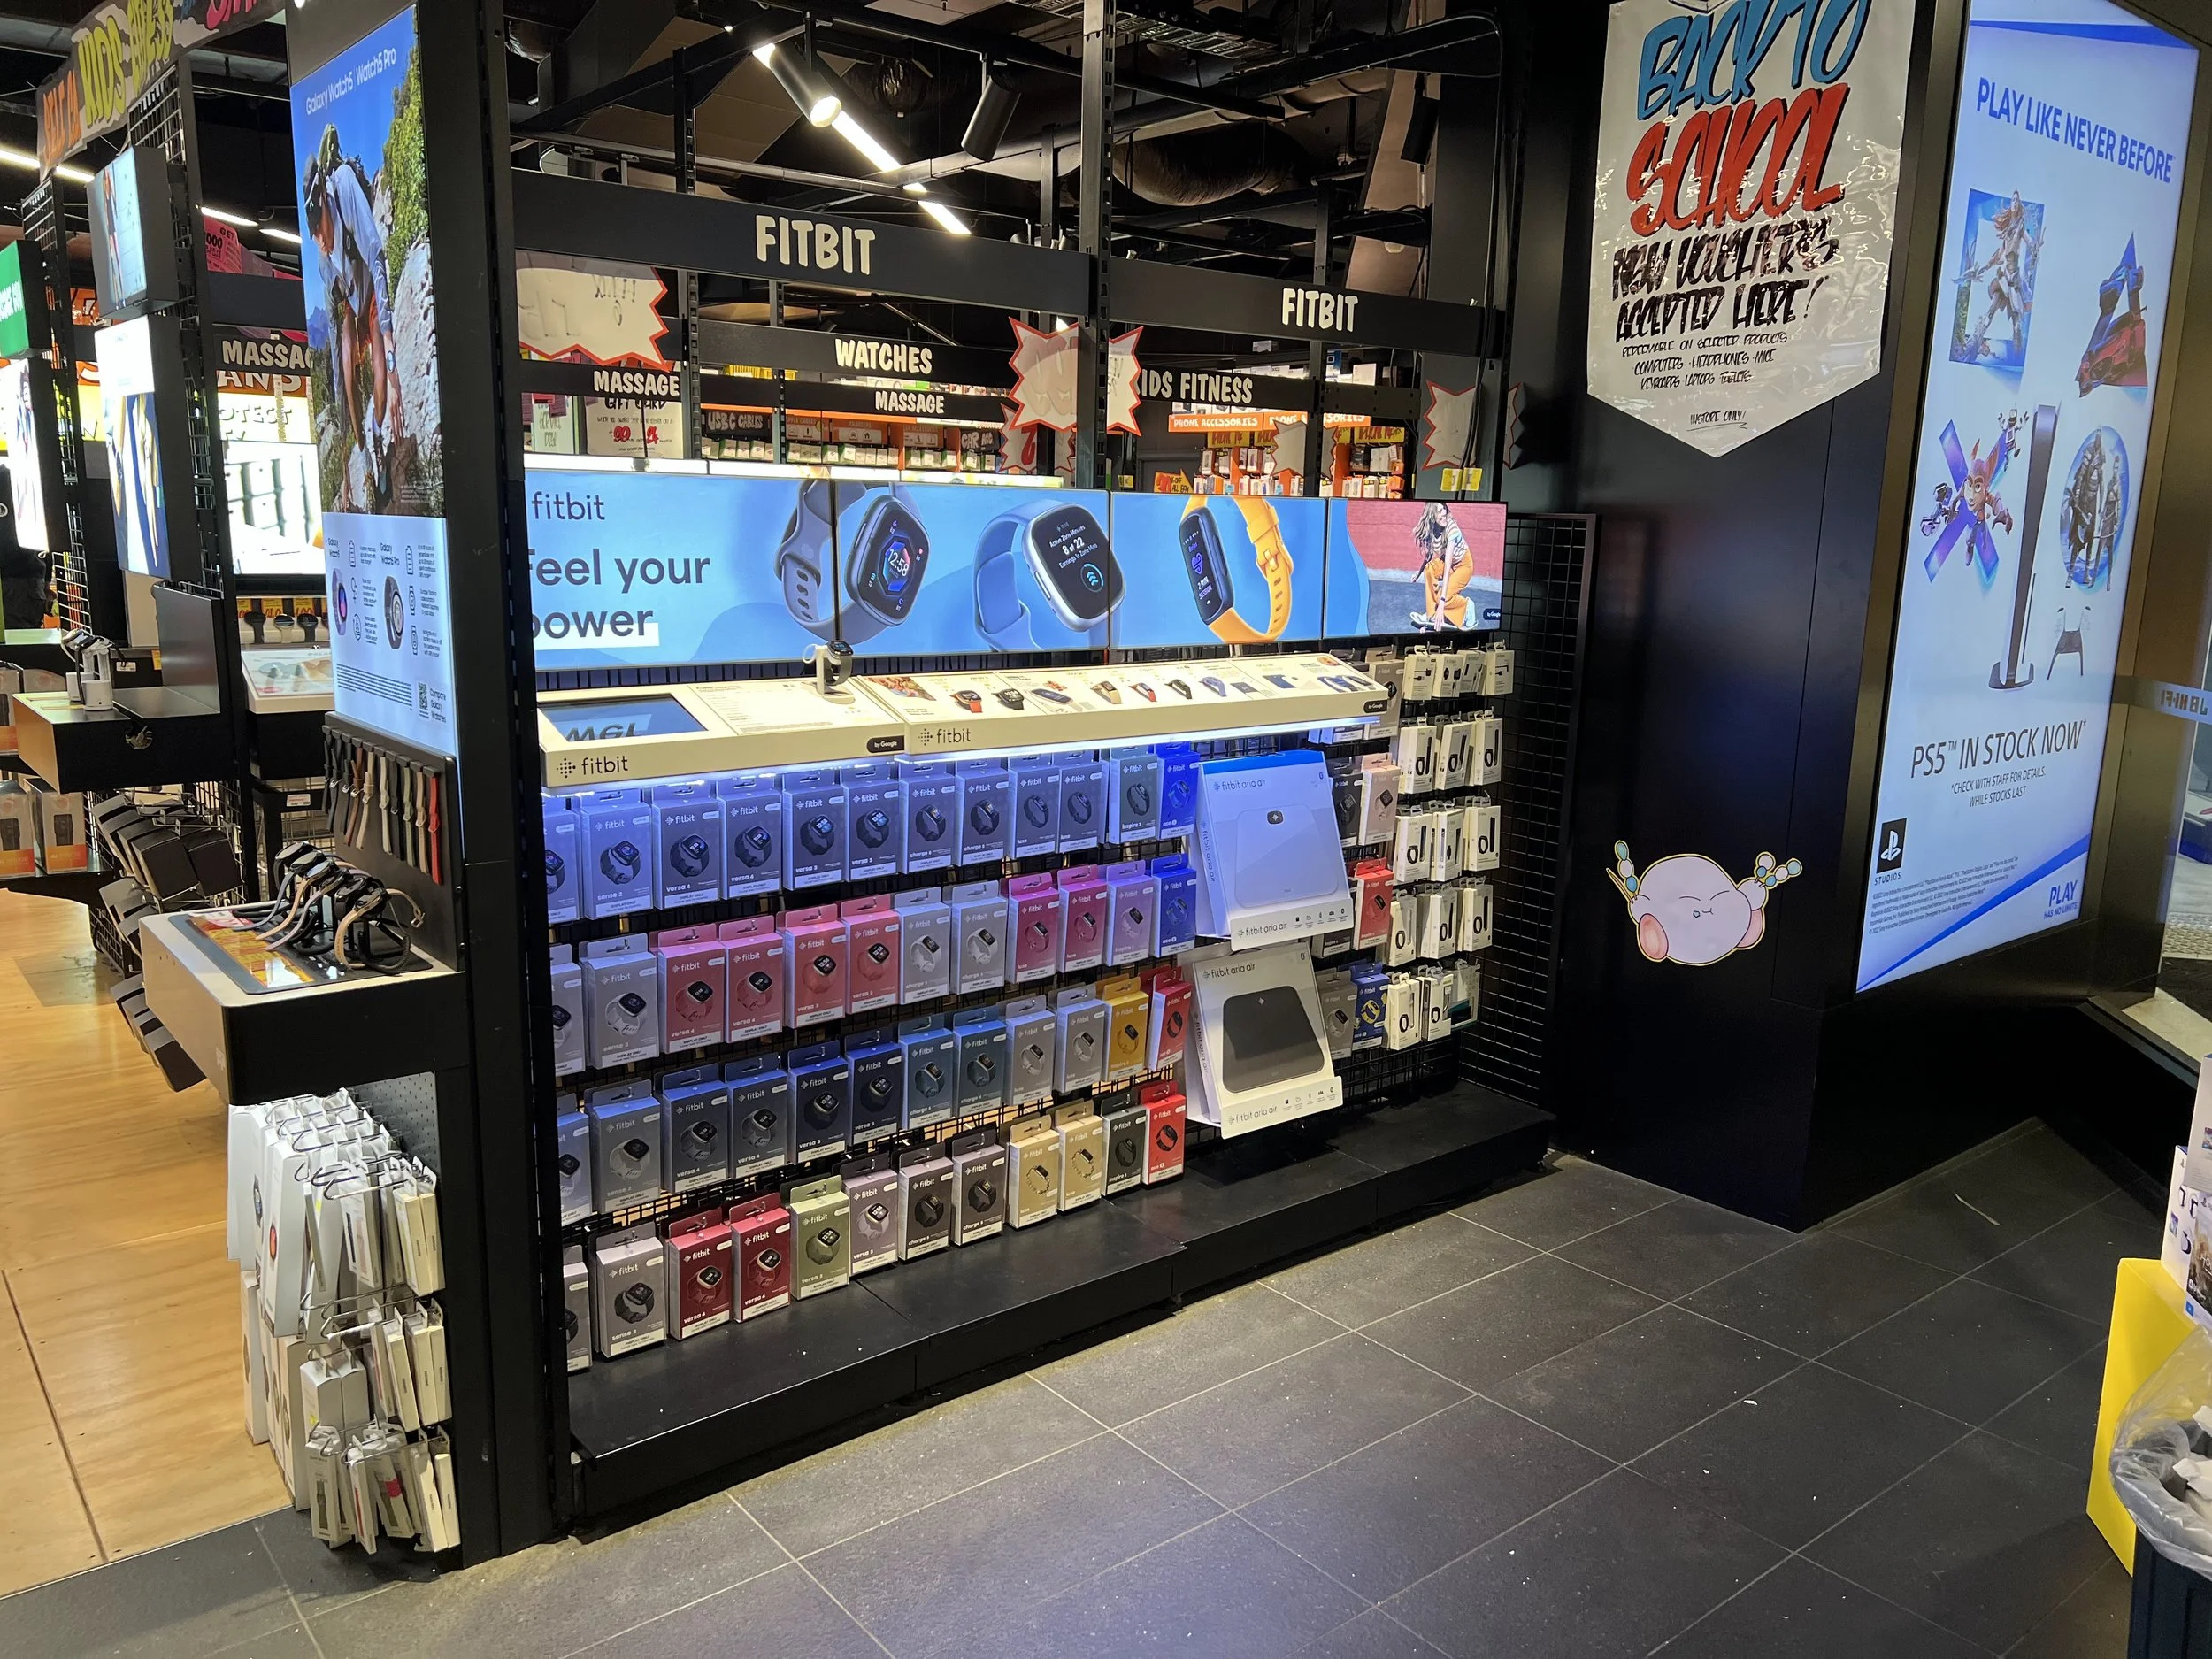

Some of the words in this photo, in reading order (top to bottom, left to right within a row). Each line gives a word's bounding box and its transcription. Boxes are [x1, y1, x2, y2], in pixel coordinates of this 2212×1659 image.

[1638, 0, 1788, 120] BACK
[1786, 0, 1871, 89] TO
[78, 16, 126, 129] KIDS
[306, 89, 328, 115] Galaxy
[383, 48, 396, 70] Pro
[1977, 77, 2024, 126] PLAY
[2025, 96, 2062, 142] LIKE
[2064, 112, 2116, 163] NEVER
[1626, 83, 1850, 237] SCHOOL
[756, 215, 876, 276] FITBIT
[1612, 240, 1673, 301] NEW
[1281, 288, 1358, 332] FITBIT
[1616, 285, 1725, 343] ACCEPTED
[1679, 339, 1693, 350] ON
[1697, 335, 1740, 349] SELECTED
[1743, 332, 1787, 349] PRODUCTS
[835, 338, 933, 374] WATCHES
[594, 370, 680, 396] MASSAGE
[1180, 373, 1253, 403] FITNESS
[875, 391, 944, 414] MASSAGE
[1173, 417, 1198, 428] PHONE
[1201, 416, 1258, 428] ACCESSORIES
[532, 491, 605, 520] fitbit
[1061, 533, 1071, 541] Zone
[1070, 525, 1086, 536] Minutes
[1062, 545, 1070, 555] 8
[1069, 543, 1075, 552] of
[1073, 536, 1085, 549] 22
[888, 549, 909, 577] 12:58
[614, 558, 710, 594] your
[936, 728, 972, 745] fitbit
[1959, 737, 1979, 770] IN
[1982, 726, 2039, 765] STOCK
[581, 756, 629, 776] fitbit
[1027, 777, 1042, 786] fitbit
[1222, 780, 1240, 791] fitbit
[1241, 780, 1256, 789] aria
[1975, 776, 1991, 790] WITH
[1992, 772, 2011, 787] STAFF
[2010, 771, 2022, 784] FOR
[805, 799, 823, 808] fitbit
[861, 794, 879, 803] fitbit
[1969, 794, 1988, 809] WHILE
[1989, 789, 2011, 803] STOCKS
[2012, 785, 2027, 797] LAST
[740, 806, 759, 815] fitbit
[605, 819, 625, 829] fitbit
[675, 814, 695, 824] fitbit
[1874, 872, 1901, 886] STUDIOS
[2049, 879, 2078, 907] PLAY
[863, 928, 879, 937] fitbit
[1246, 926, 1263, 936] fitbit
[1263, 924, 1278, 933] aria
[807, 940, 825, 949] fitbit
[741, 952, 761, 962] fitbit
[680, 962, 701, 972] fitbit
[1210, 966, 1230, 979] fitbit
[1231, 964, 1245, 975] aria
[1246, 963, 1256, 972] air
[611, 972, 631, 983] fitbit
[972, 1039, 987, 1048] fitbit
[918, 1047, 934, 1056] fitbit
[865, 1062, 882, 1071] fitbit
[810, 1078, 826, 1087] fitbit
[747, 1090, 764, 1101] fitbit
[686, 1102, 704, 1112] fitbit
[1235, 1110, 1253, 1123] fitbit
[1254, 1108, 1268, 1118] aria
[616, 1119, 635, 1131] fitbit
[1118, 1121, 1132, 1131] fitbit
[972, 1164, 987, 1173] fitbit
[919, 1179, 935, 1188] fitbit
[861, 1188, 878, 1199] fitbit
[810, 1213, 828, 1225] fitbit
[752, 1231, 770, 1243] fitbit
[692, 1248, 710, 1261] fitbit
[618, 1263, 639, 1276] fitbit
